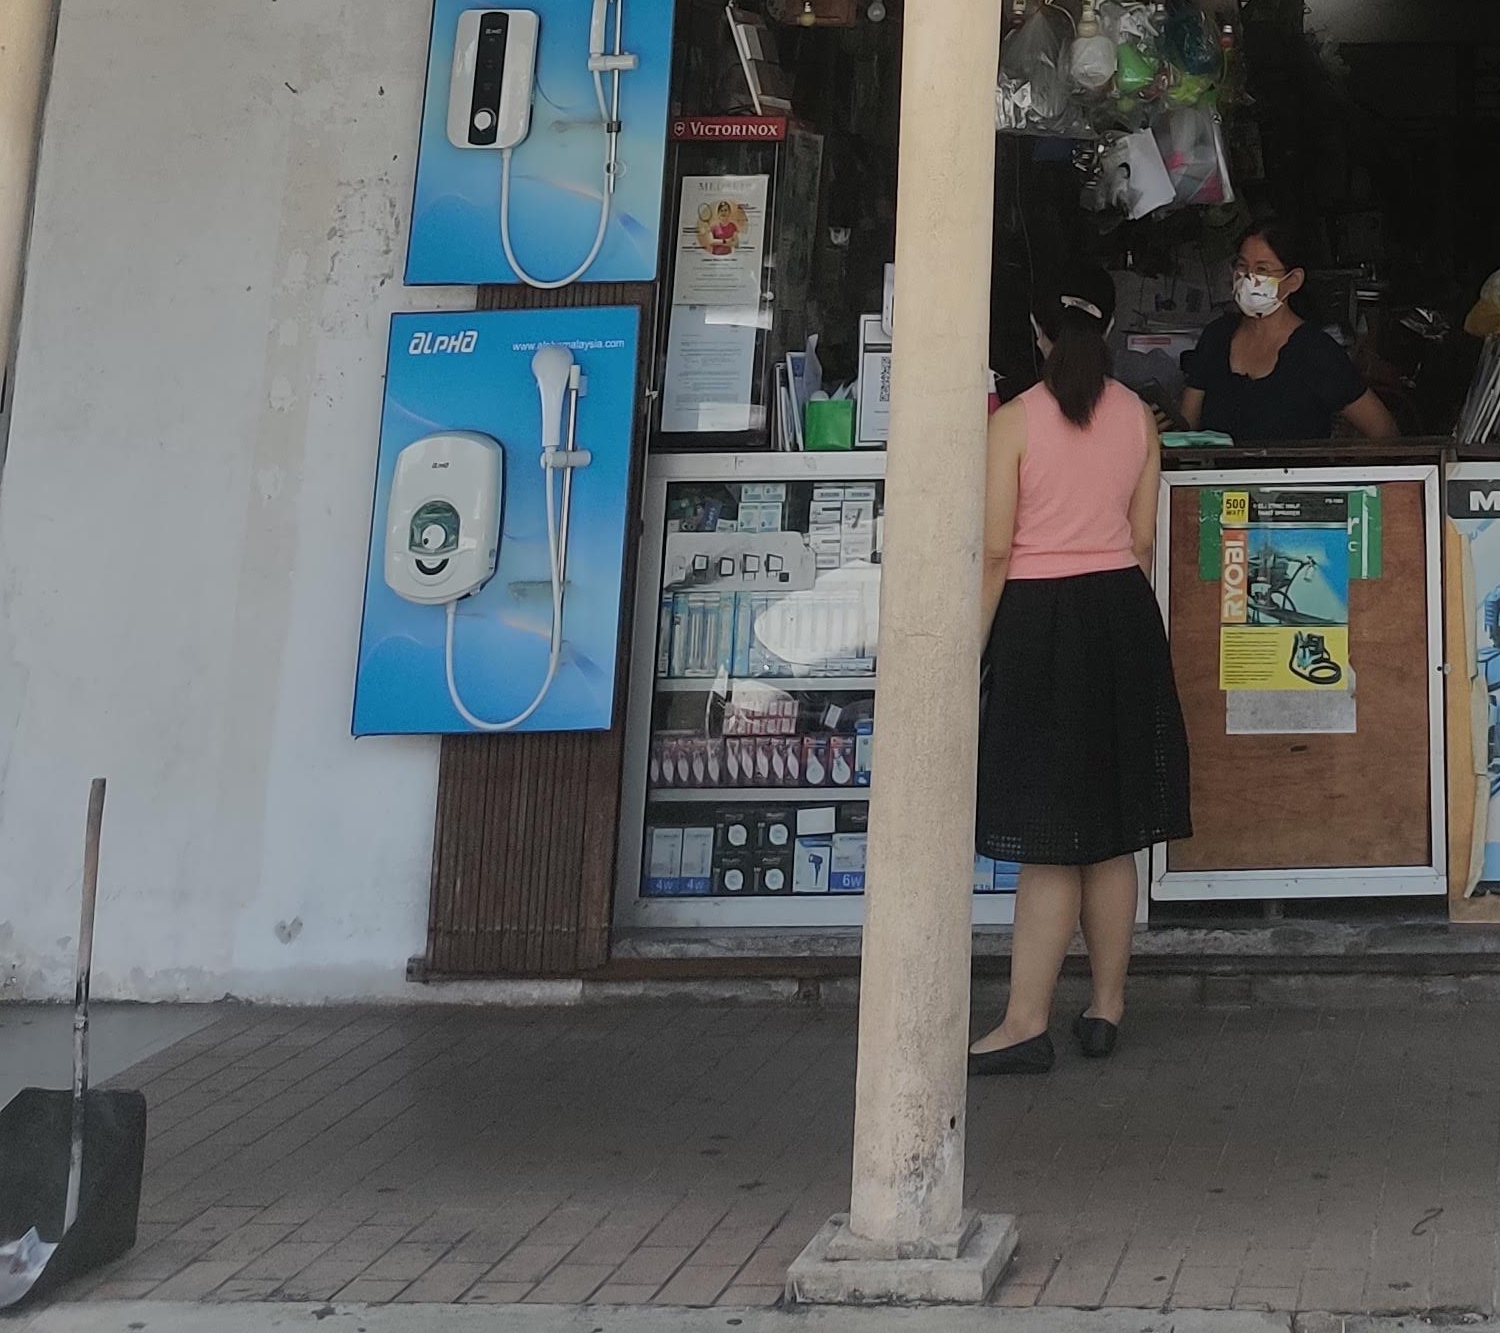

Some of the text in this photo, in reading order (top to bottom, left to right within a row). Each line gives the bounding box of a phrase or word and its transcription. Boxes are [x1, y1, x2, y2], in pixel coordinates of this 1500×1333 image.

[690, 121, 778, 136] VICTORINOX
[1226, 498, 1246, 510] 500
[1224, 540, 1245, 618] RYOBI
[842, 874, 862, 888] 6W
